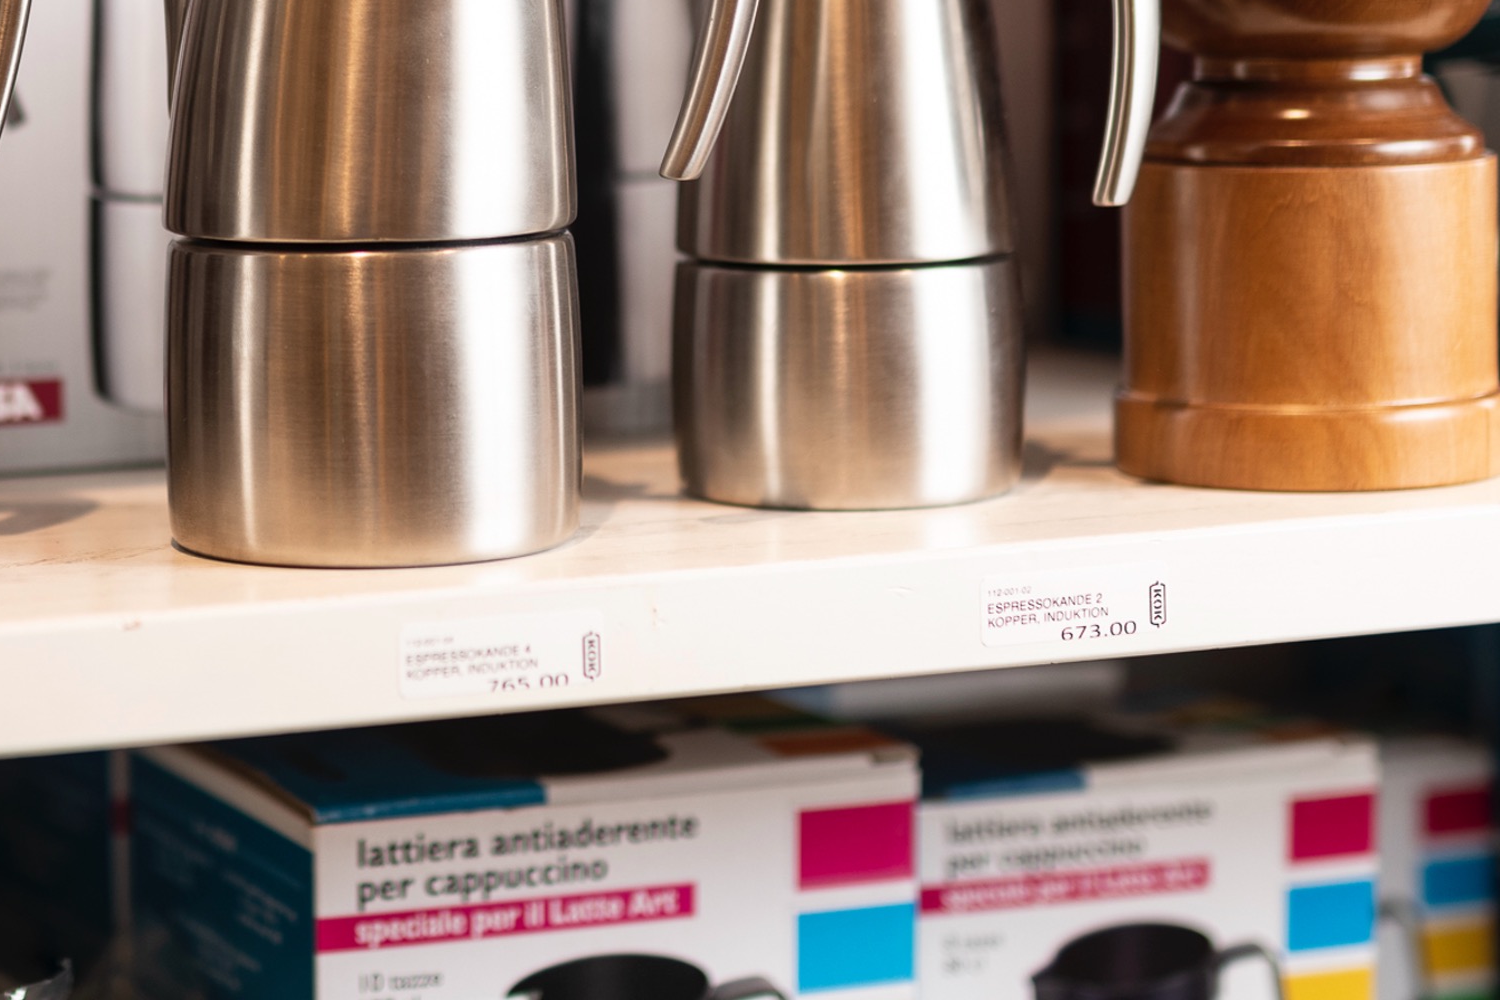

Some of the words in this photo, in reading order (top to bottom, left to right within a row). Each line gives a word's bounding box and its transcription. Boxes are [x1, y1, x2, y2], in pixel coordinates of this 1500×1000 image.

[987, 594, 1092, 615] ESPRESSOKANDE
[1096, 593, 1103, 604] 2
[987, 612, 1040, 629] KOPPER,
[1043, 606, 1109, 623] INDUKTION
[1061, 620, 1137, 641] 673.00
[357, 833, 480, 868] lattiera
[489, 815, 699, 857] antiaderente
[357, 877, 414, 911] per
[424, 857, 610, 902] cappuccino
[354, 909, 467, 949] speciale
[470, 904, 521, 939] per
[524, 898, 544, 927] il
[549, 890, 622, 926] Latte
[627, 886, 681, 917] Art
